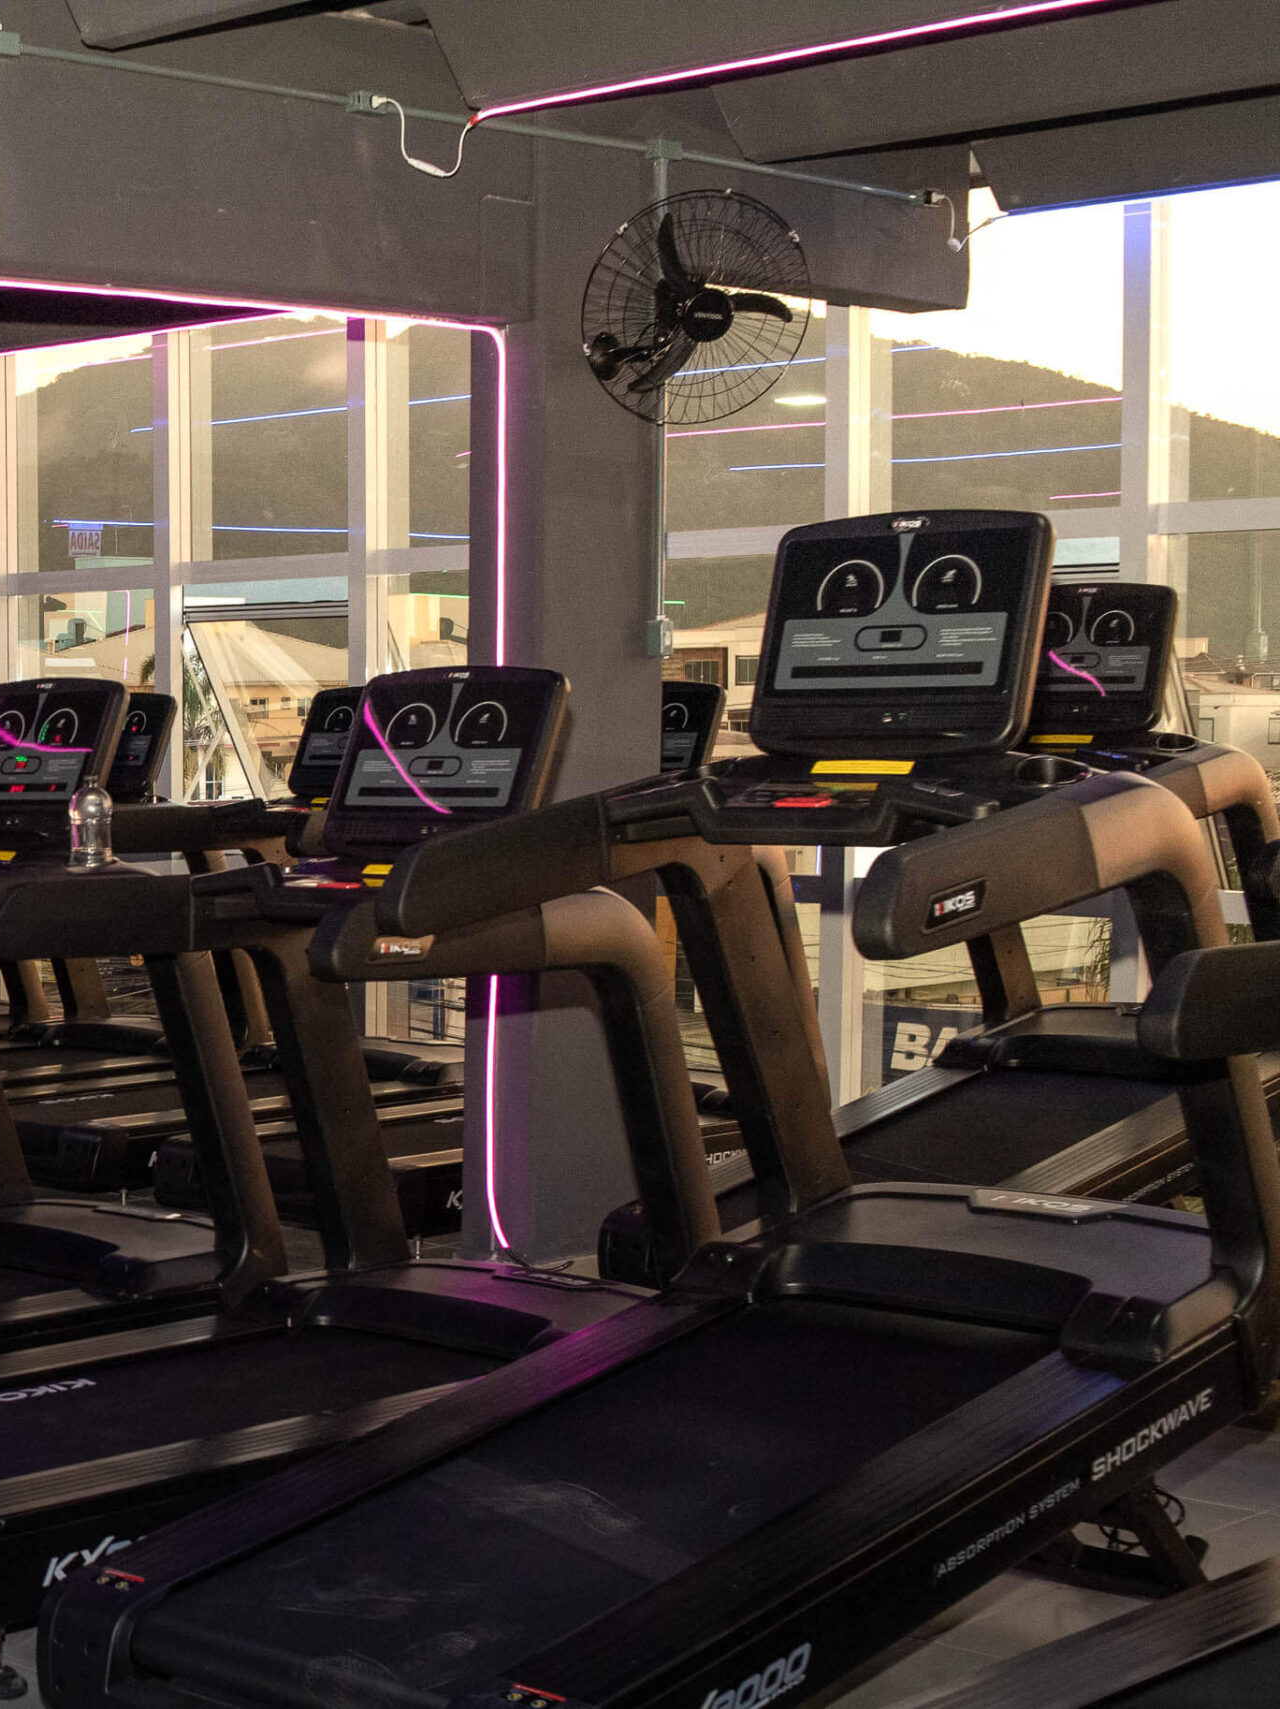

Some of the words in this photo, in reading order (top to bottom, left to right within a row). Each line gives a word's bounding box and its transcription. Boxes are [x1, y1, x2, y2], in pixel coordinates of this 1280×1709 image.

[936, 1511, 1027, 1579] ABSORPTION
[1028, 1476, 1081, 1520] SYSTEM
[1090, 1386, 1214, 1482] SHOCKWAVE
